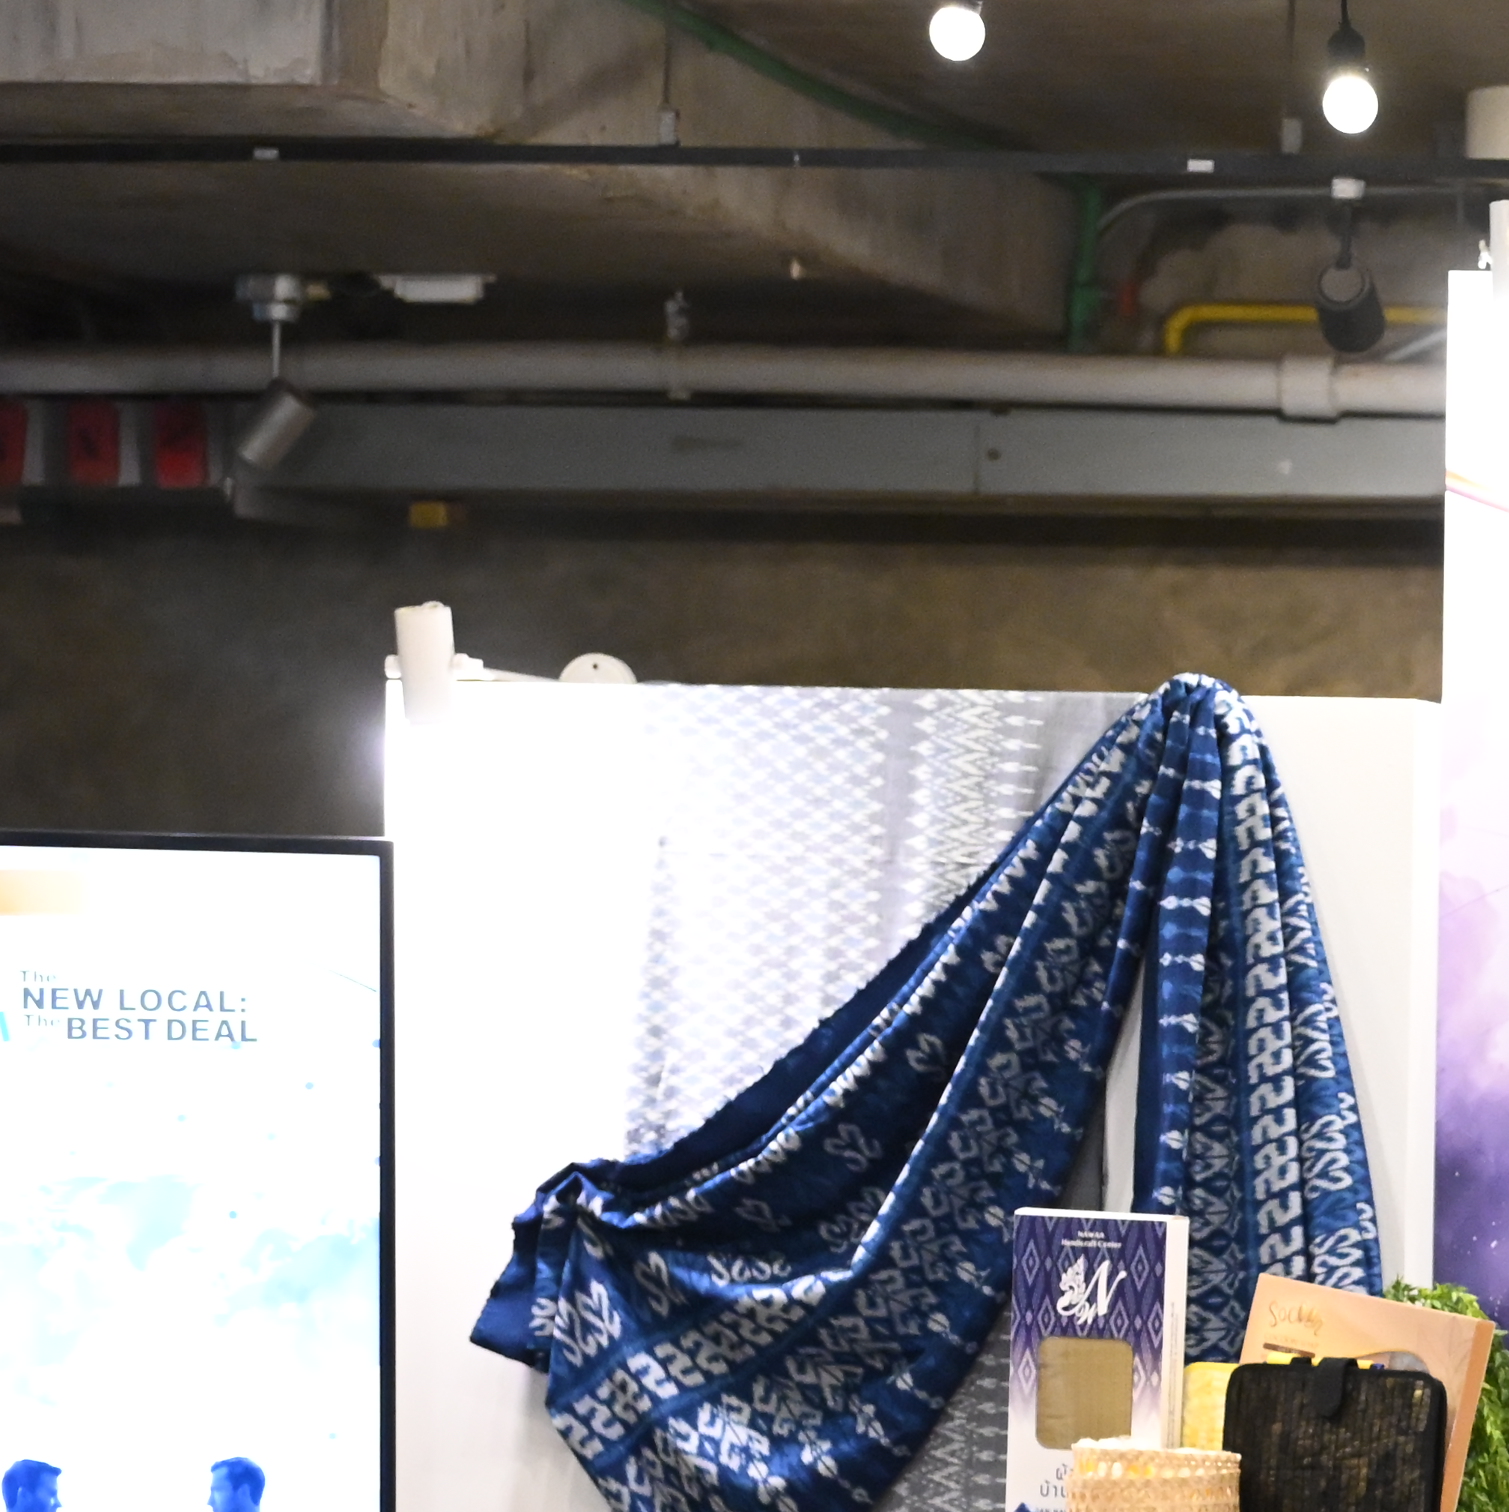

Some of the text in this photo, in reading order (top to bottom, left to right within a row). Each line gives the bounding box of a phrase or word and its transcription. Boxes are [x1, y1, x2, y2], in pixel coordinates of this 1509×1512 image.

[20, 970, 56, 982] The
[23, 987, 246, 1012] NEW LOCAL:
[25, 1014, 257, 1042] The BEST DEAL
